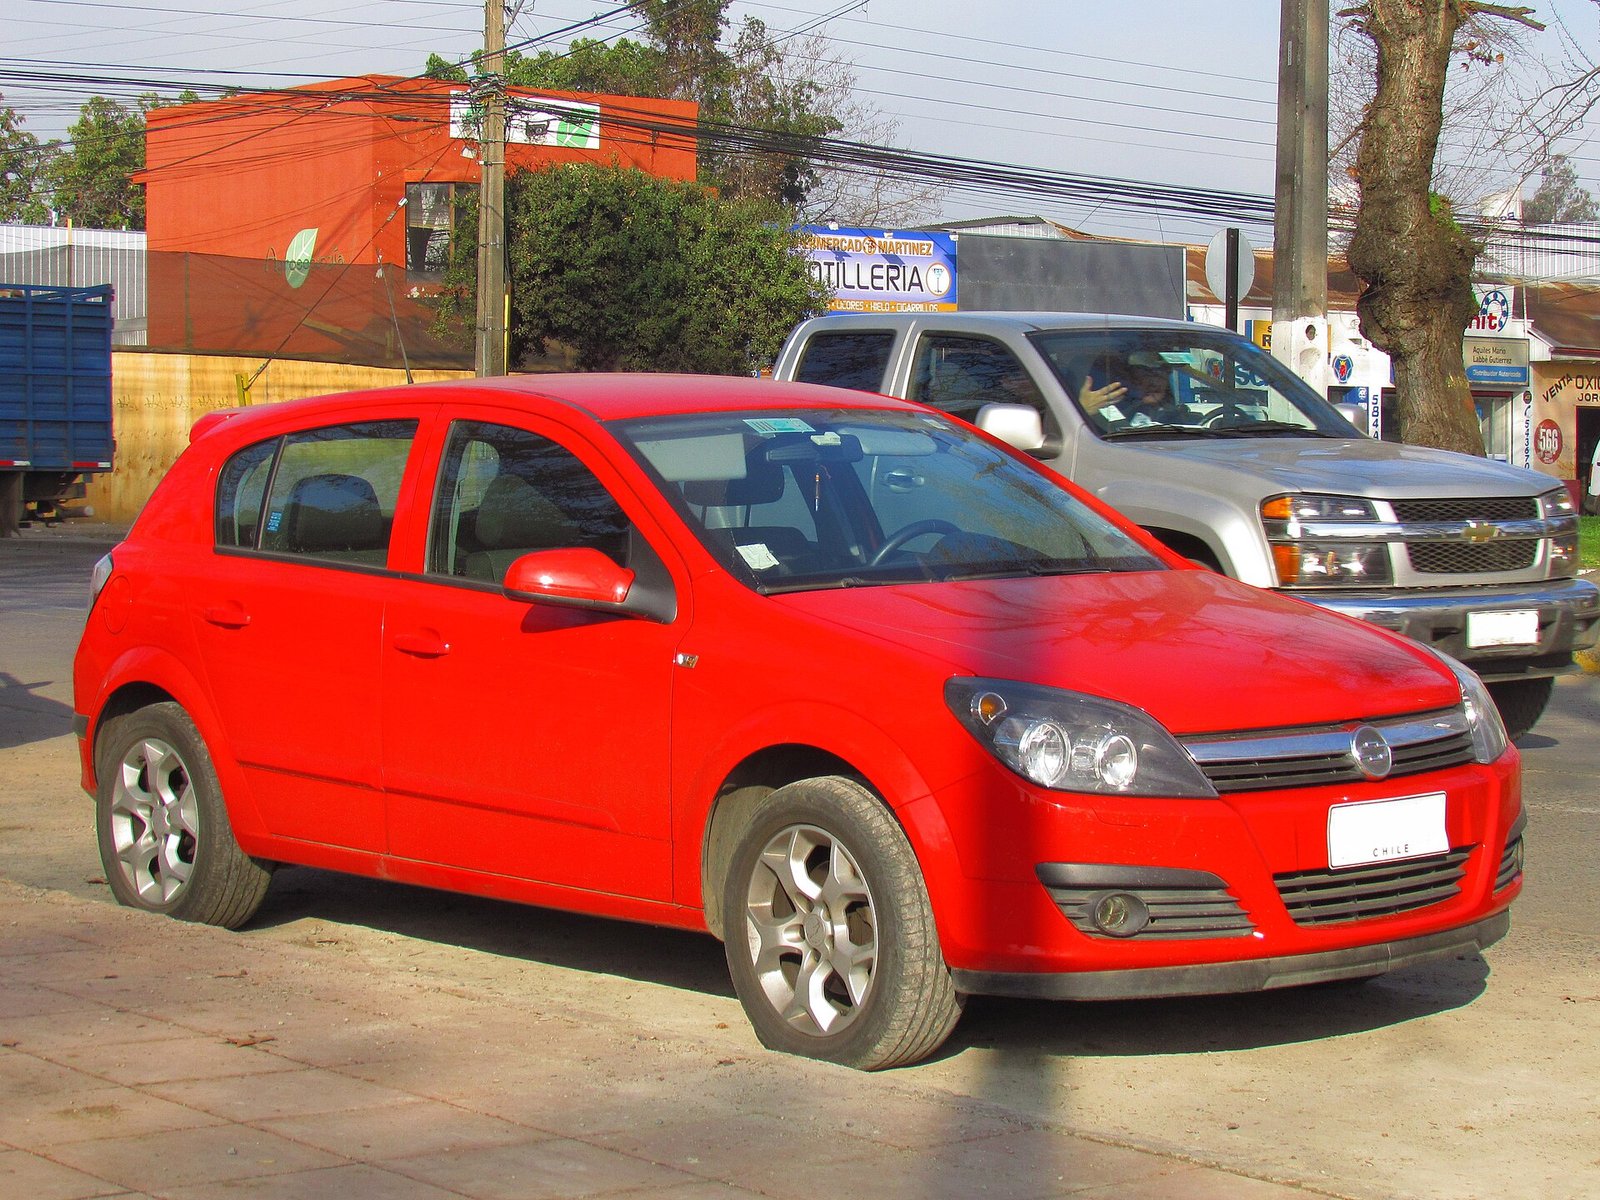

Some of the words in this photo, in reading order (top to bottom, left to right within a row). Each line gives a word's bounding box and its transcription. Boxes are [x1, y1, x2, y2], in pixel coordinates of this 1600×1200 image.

[877, 240, 932, 256] MARTINEZ
[1542, 374, 1574, 403] VENTA
[1577, 392, 1600, 402] JOR
[1373, 843, 1409, 857] CHILE
